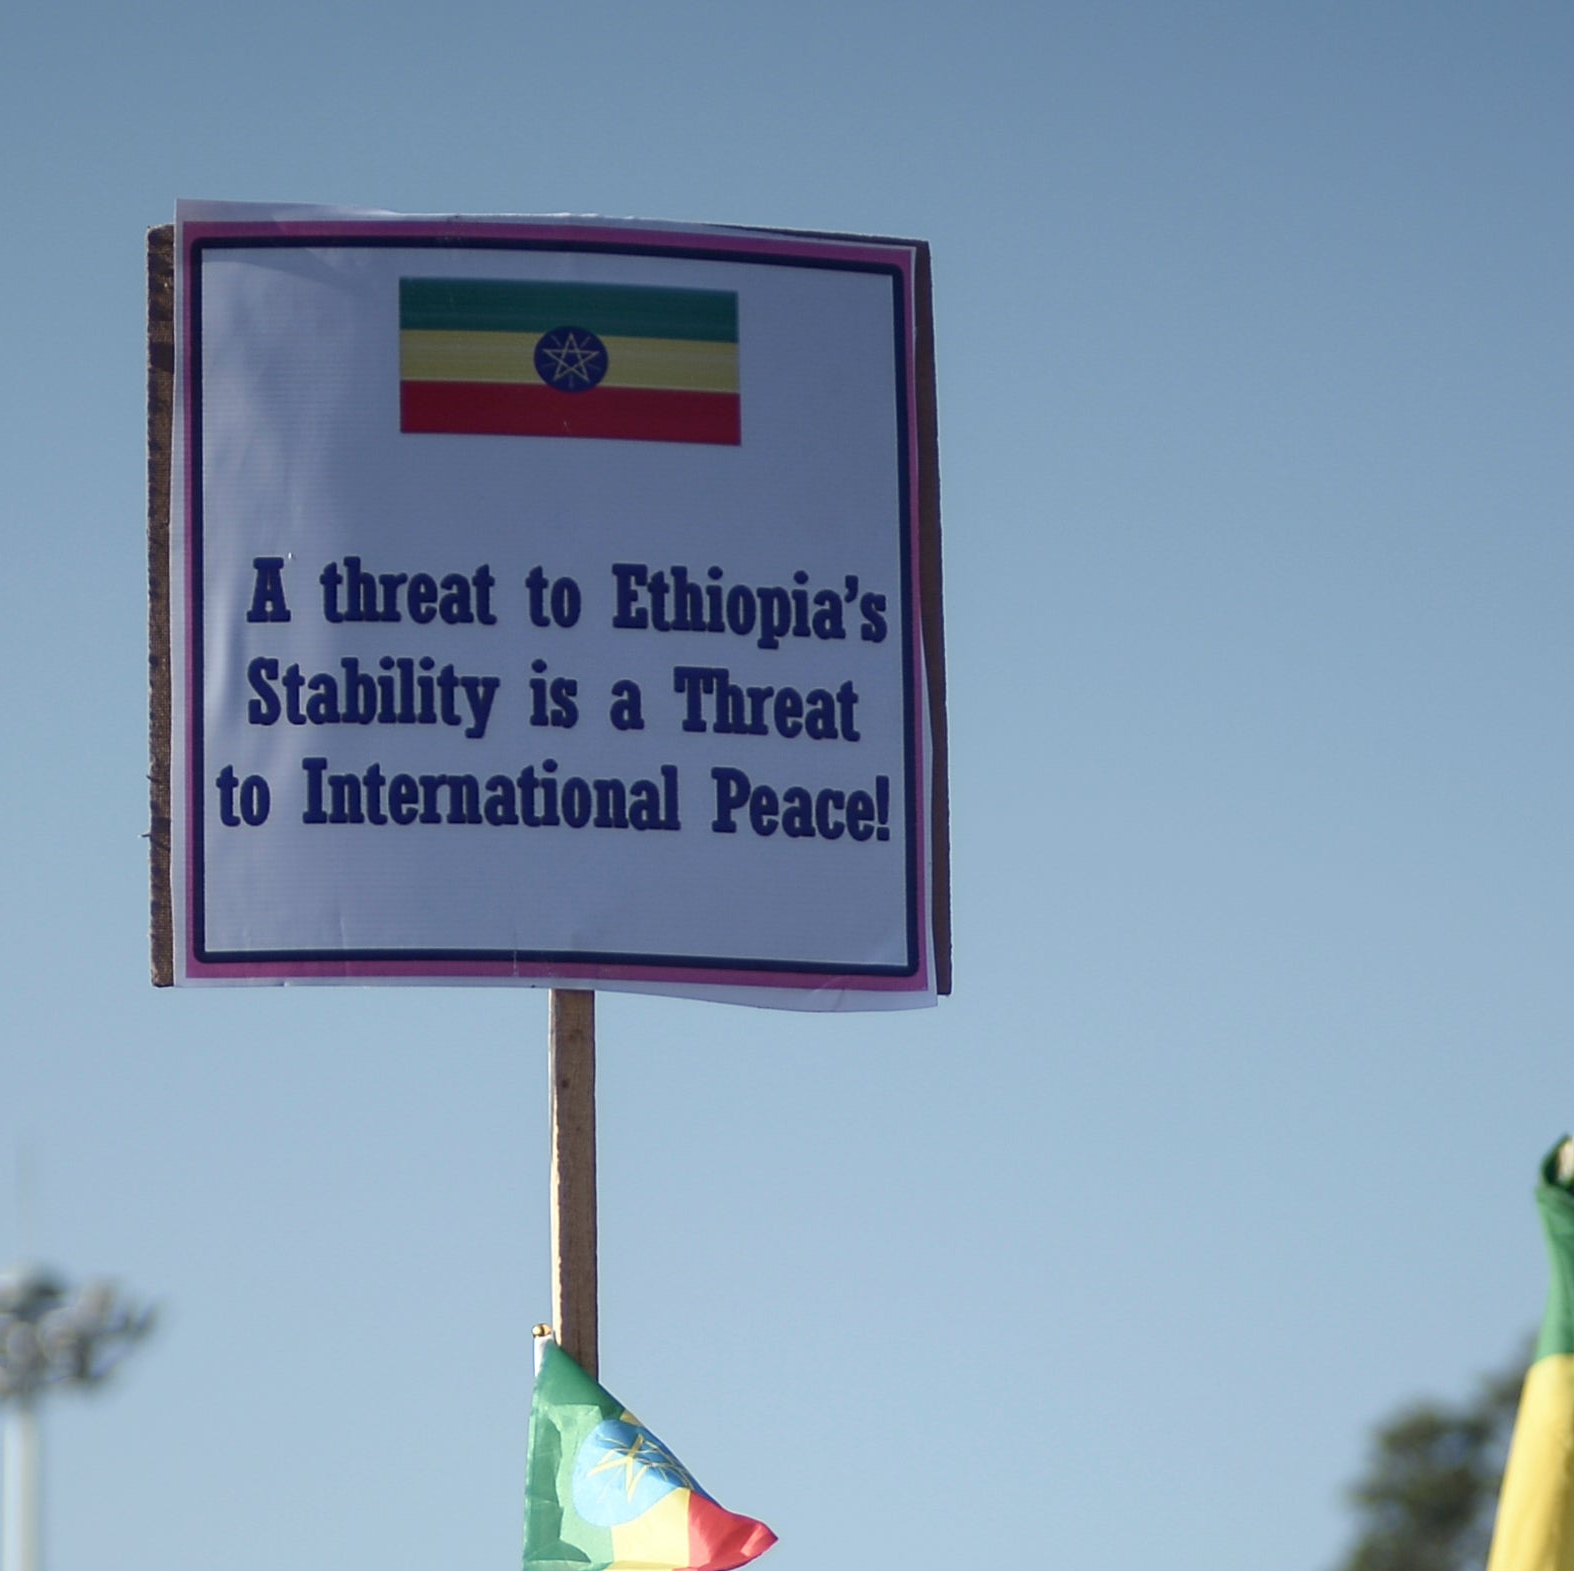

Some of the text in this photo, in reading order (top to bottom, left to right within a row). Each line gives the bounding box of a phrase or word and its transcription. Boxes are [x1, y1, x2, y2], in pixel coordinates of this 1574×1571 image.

[245, 556, 888, 650] A threat to Ethiopia's
[247, 656, 861, 743] Stability is a Threat
[215, 757, 891, 843] to International Peace!
